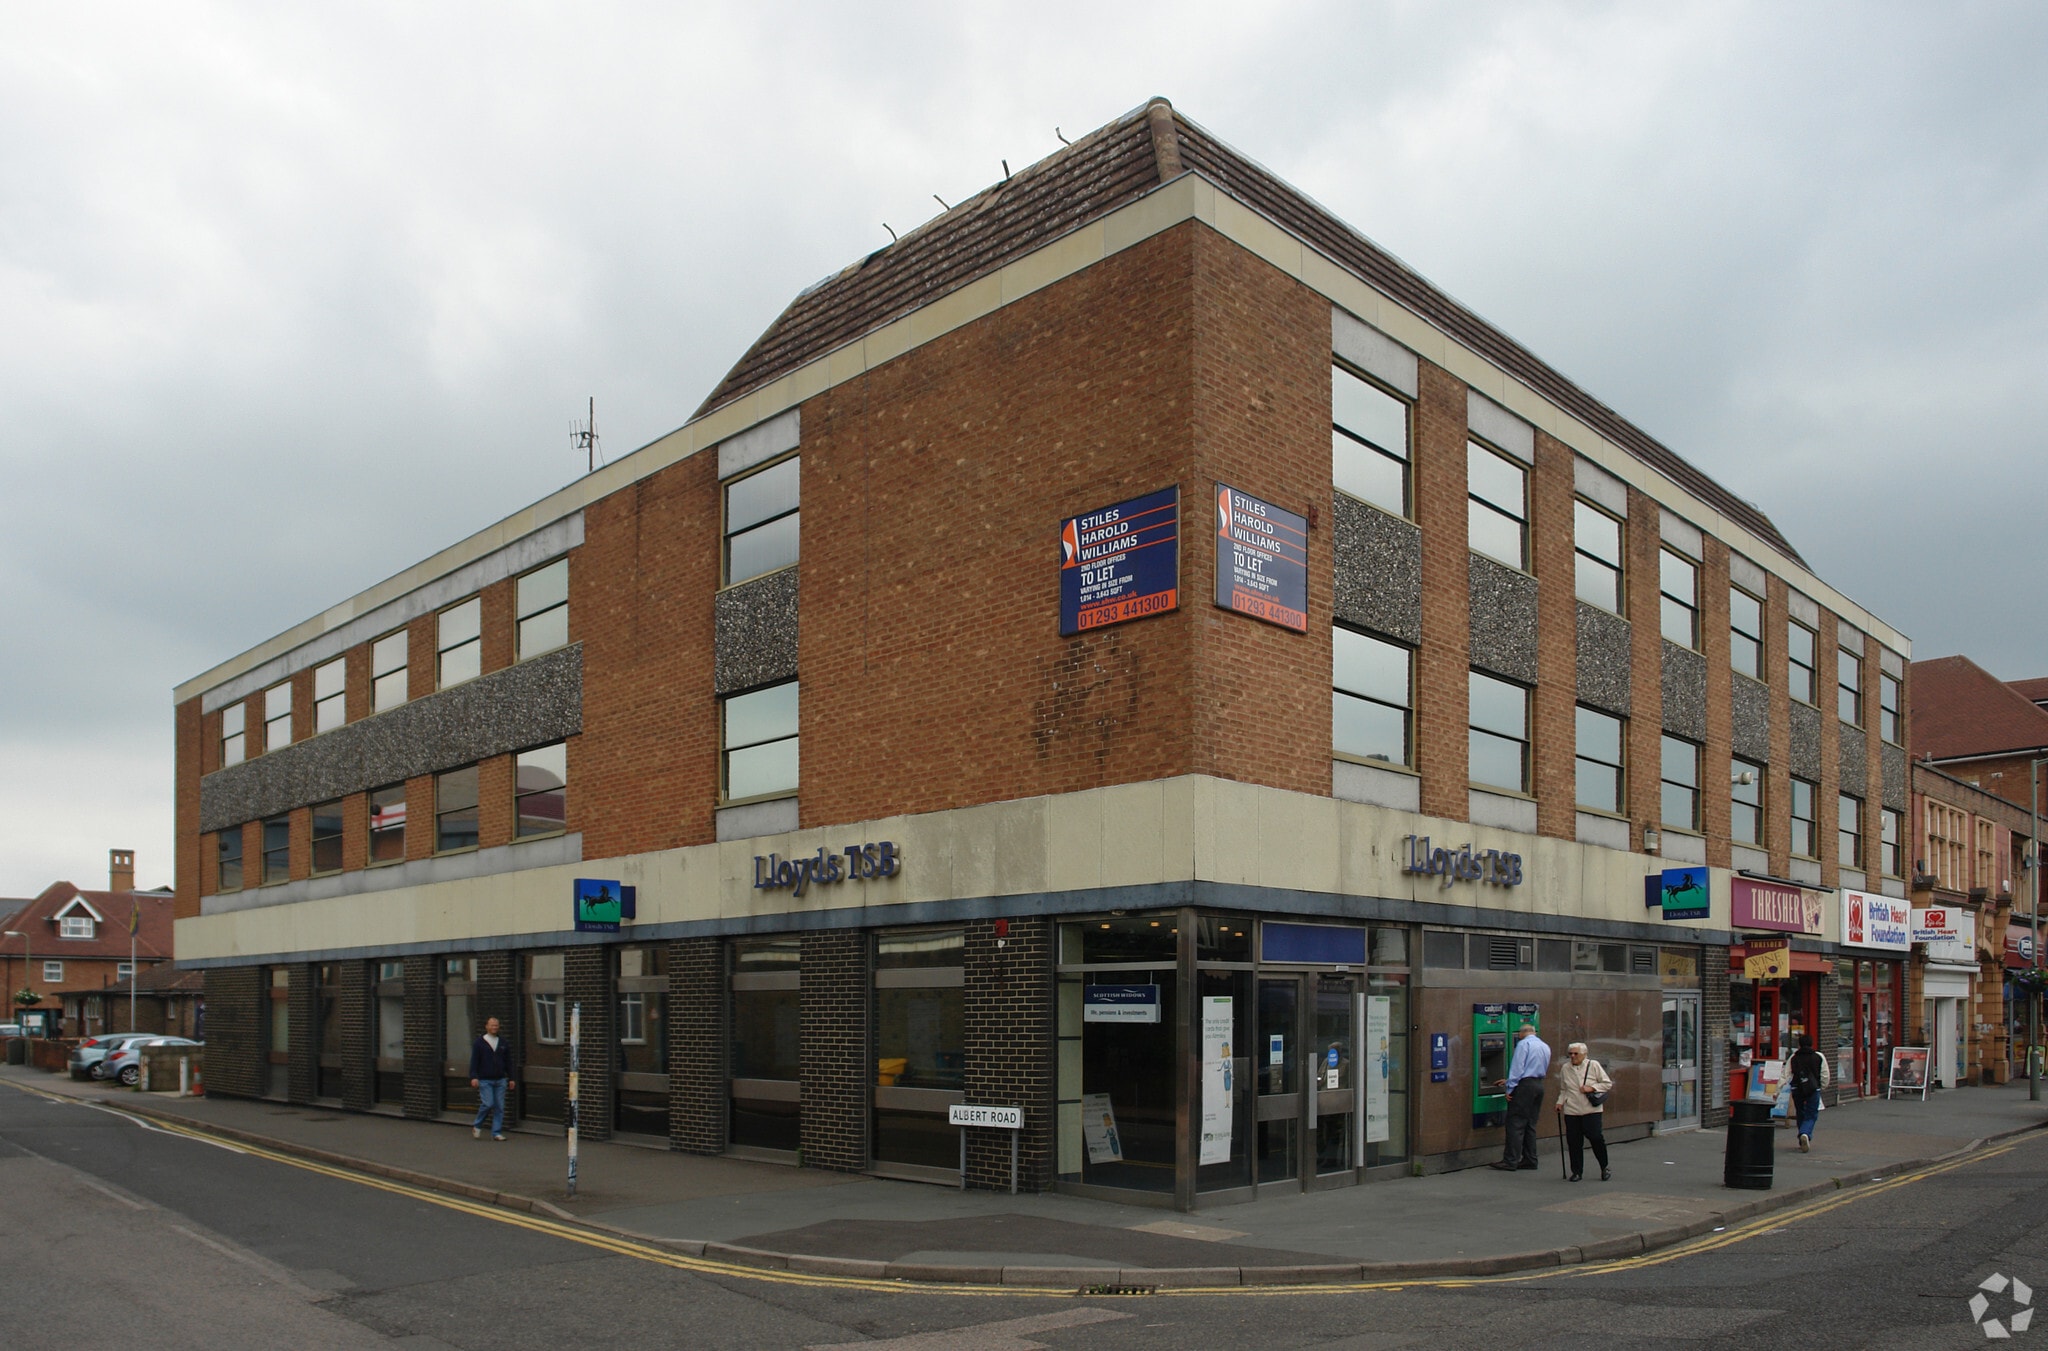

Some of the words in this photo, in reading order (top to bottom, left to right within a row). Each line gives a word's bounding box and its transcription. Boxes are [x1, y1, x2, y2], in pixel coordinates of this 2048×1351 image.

[1234, 496, 1266, 517] STILES
[1081, 509, 1120, 530] STILES
[1234, 511, 1274, 534] HAROLD
[1081, 522, 1128, 545] HAROLD
[1234, 527, 1281, 552] WILLIAMS
[1081, 535, 1138, 560] WILLIAMS
[1243, 546, 1256, 556] FLOOR
[1257, 550, 1272, 562] OFFICES
[1091, 559, 1107, 570] FLOOR
[1107, 554, 1126, 566] OFFICES
[1234, 552, 1244, 567] TO
[1247, 556, 1263, 573] LET
[1080, 572, 1094, 586] TO
[1097, 566, 1114, 582] LET
[1080, 585, 1100, 594] VARYING
[1102, 582, 1107, 590] IN
[1108, 579, 1118, 588] SIZE
[1119, 575, 1133, 585] FROM
[1080, 606, 1118, 628] 01293
[1123, 594, 1168, 617] 441300
[1234, 594, 1265, 616] 01293
[1269, 606, 1302, 627] 441300
[754, 846, 842, 897] Lloyds
[844, 841, 899, 880] TSB
[1403, 834, 1482, 889] Lloyds
[1482, 848, 1523, 886] TSB
[1751, 888, 1800, 924] THRESHER
[1869, 902, 1889, 922] British
[1891, 905, 1907, 925] Heart
[1871, 924, 1906, 944] Foundation
[1749, 952, 1781, 967] WINE
[952, 1110, 987, 1122] ALBERT
[991, 1112, 1016, 1123] ROAD
